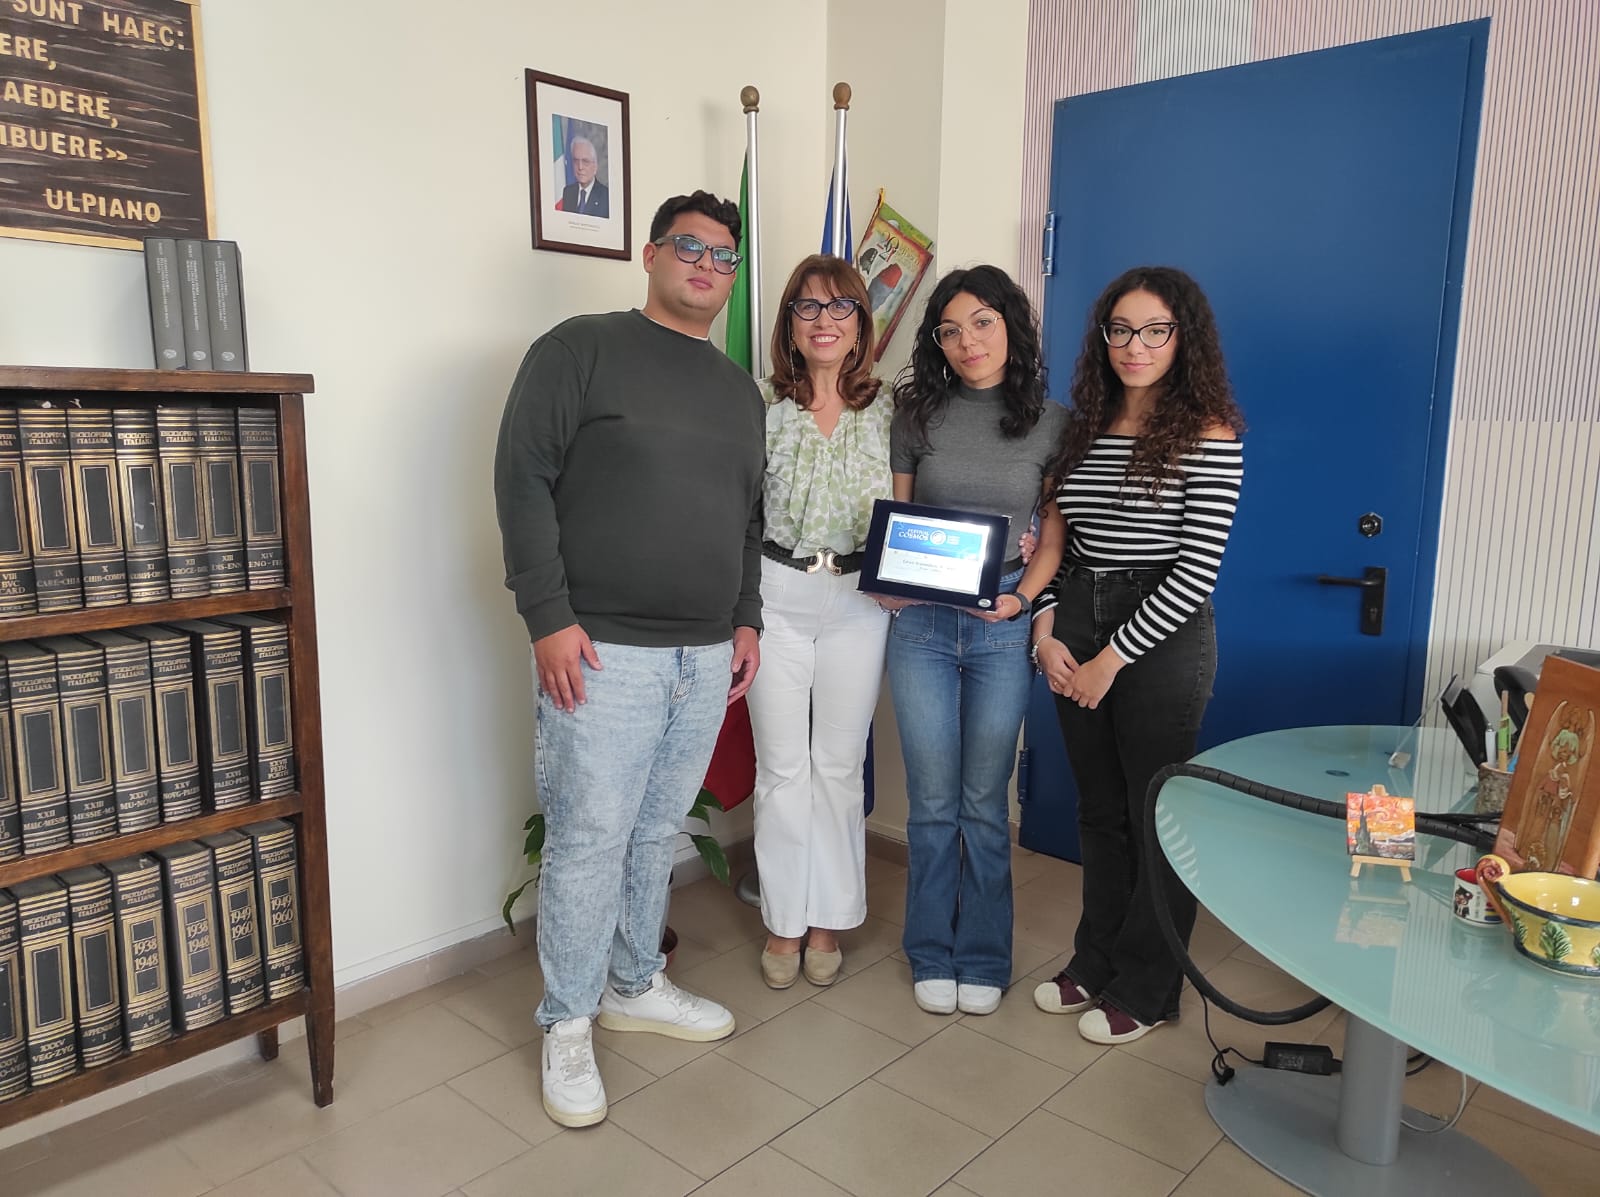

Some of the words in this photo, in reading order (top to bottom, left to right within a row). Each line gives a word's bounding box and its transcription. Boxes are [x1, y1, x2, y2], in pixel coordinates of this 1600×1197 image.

[12, 0, 83, 25] SUNT
[103, 11, 185, 51] HAEC:
[0, 32, 57, 71] ERE,
[4, 81, 118, 128] AEDERE,
[45, 188, 161, 223] ULPIANO
[898, 531, 930, 541] COSMOS
[261, 552, 274, 560] XIV
[101, 565, 109, 573] X
[174, 781, 191, 790] XXV
[128, 789, 150, 800] XXIV
[83, 800, 105, 811] XXIII
[36, 809, 56, 820] XXII
[271, 895, 292, 911] 1949
[230, 906, 252, 924] 1949
[272, 909, 293, 924] 1960
[187, 920, 209, 938] 1938
[231, 921, 253, 938] 1960
[133, 939, 158, 956] 1938
[188, 935, 210, 953] 1948
[134, 955, 159, 971] 1948
